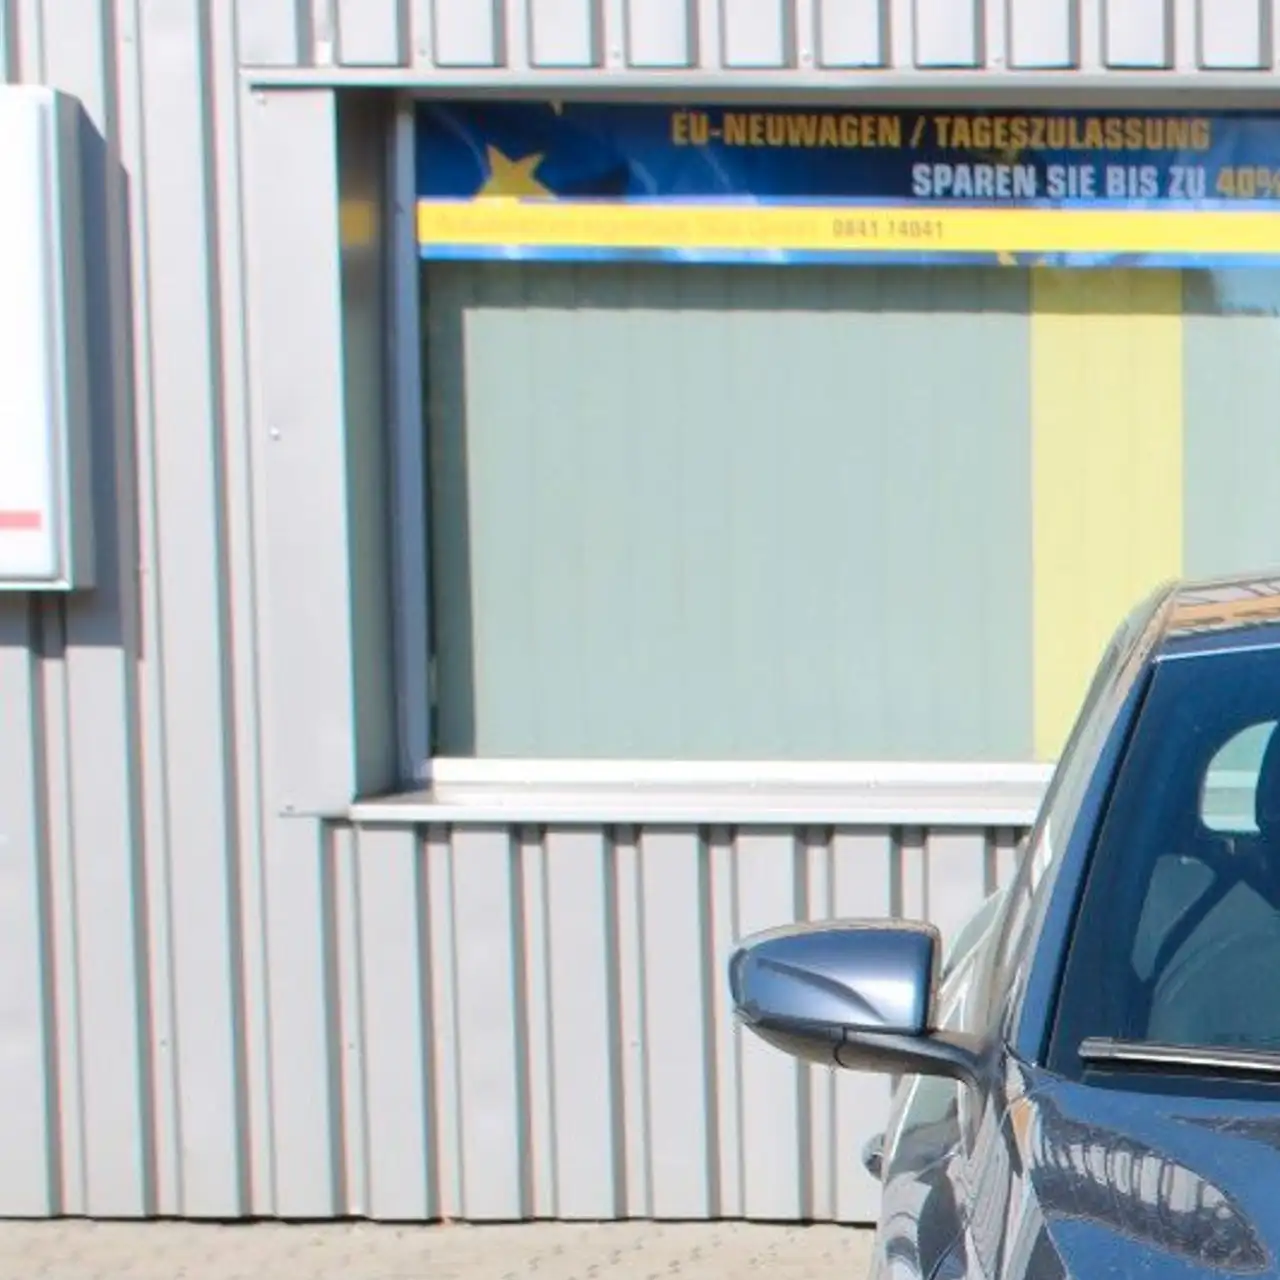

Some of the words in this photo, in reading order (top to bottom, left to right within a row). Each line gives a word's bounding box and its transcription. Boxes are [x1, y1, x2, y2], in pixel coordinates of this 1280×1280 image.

[671, 112, 900, 147] EU-NEUWAGEN
[909, 114, 927, 147] /
[934, 115, 1211, 150] TAGESZULASSUNG
[911, 163, 1036, 198] SPAREN
[1046, 165, 1098, 198] SIE
[1106, 165, 1159, 199] BIS
[1168, 166, 1206, 199] ZU
